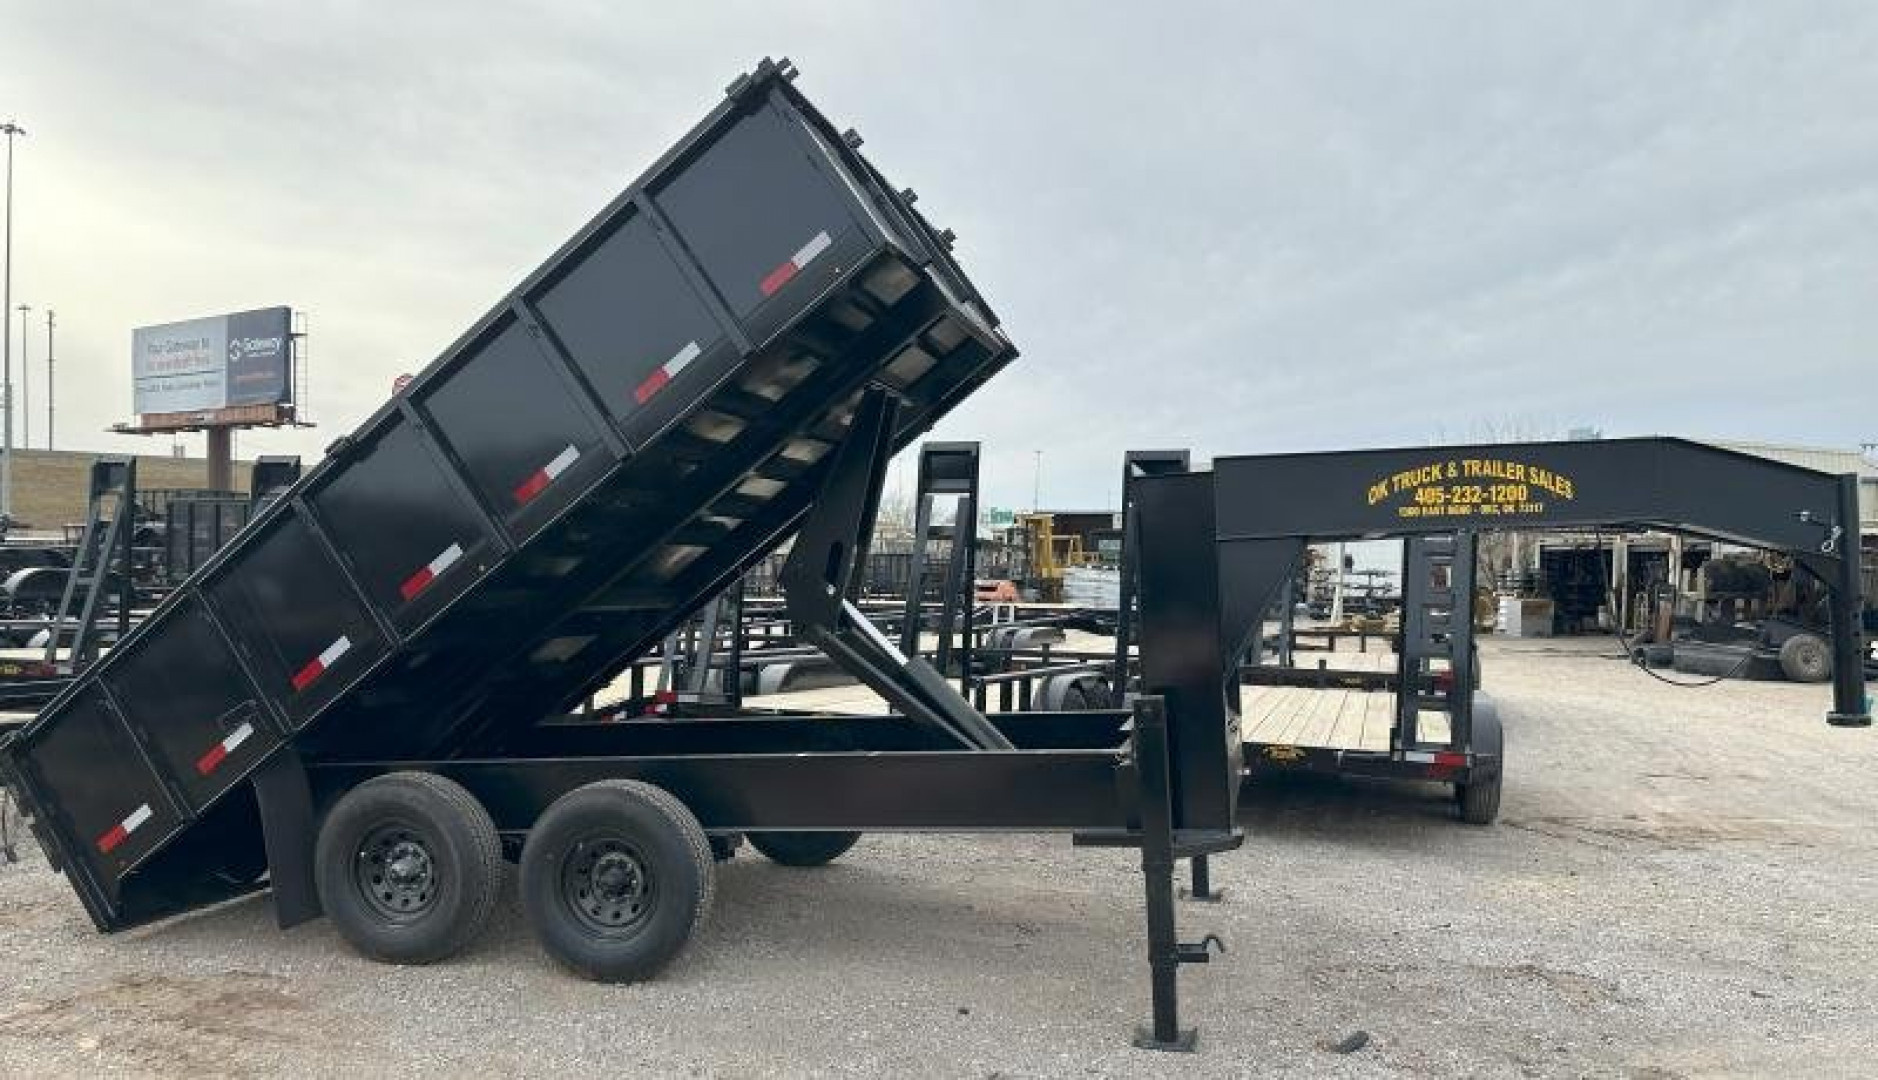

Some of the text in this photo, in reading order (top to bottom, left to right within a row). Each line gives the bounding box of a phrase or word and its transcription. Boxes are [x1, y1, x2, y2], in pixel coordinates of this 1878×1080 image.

[1368, 460, 1574, 505] OK TRUCK & TRAILER SALES
